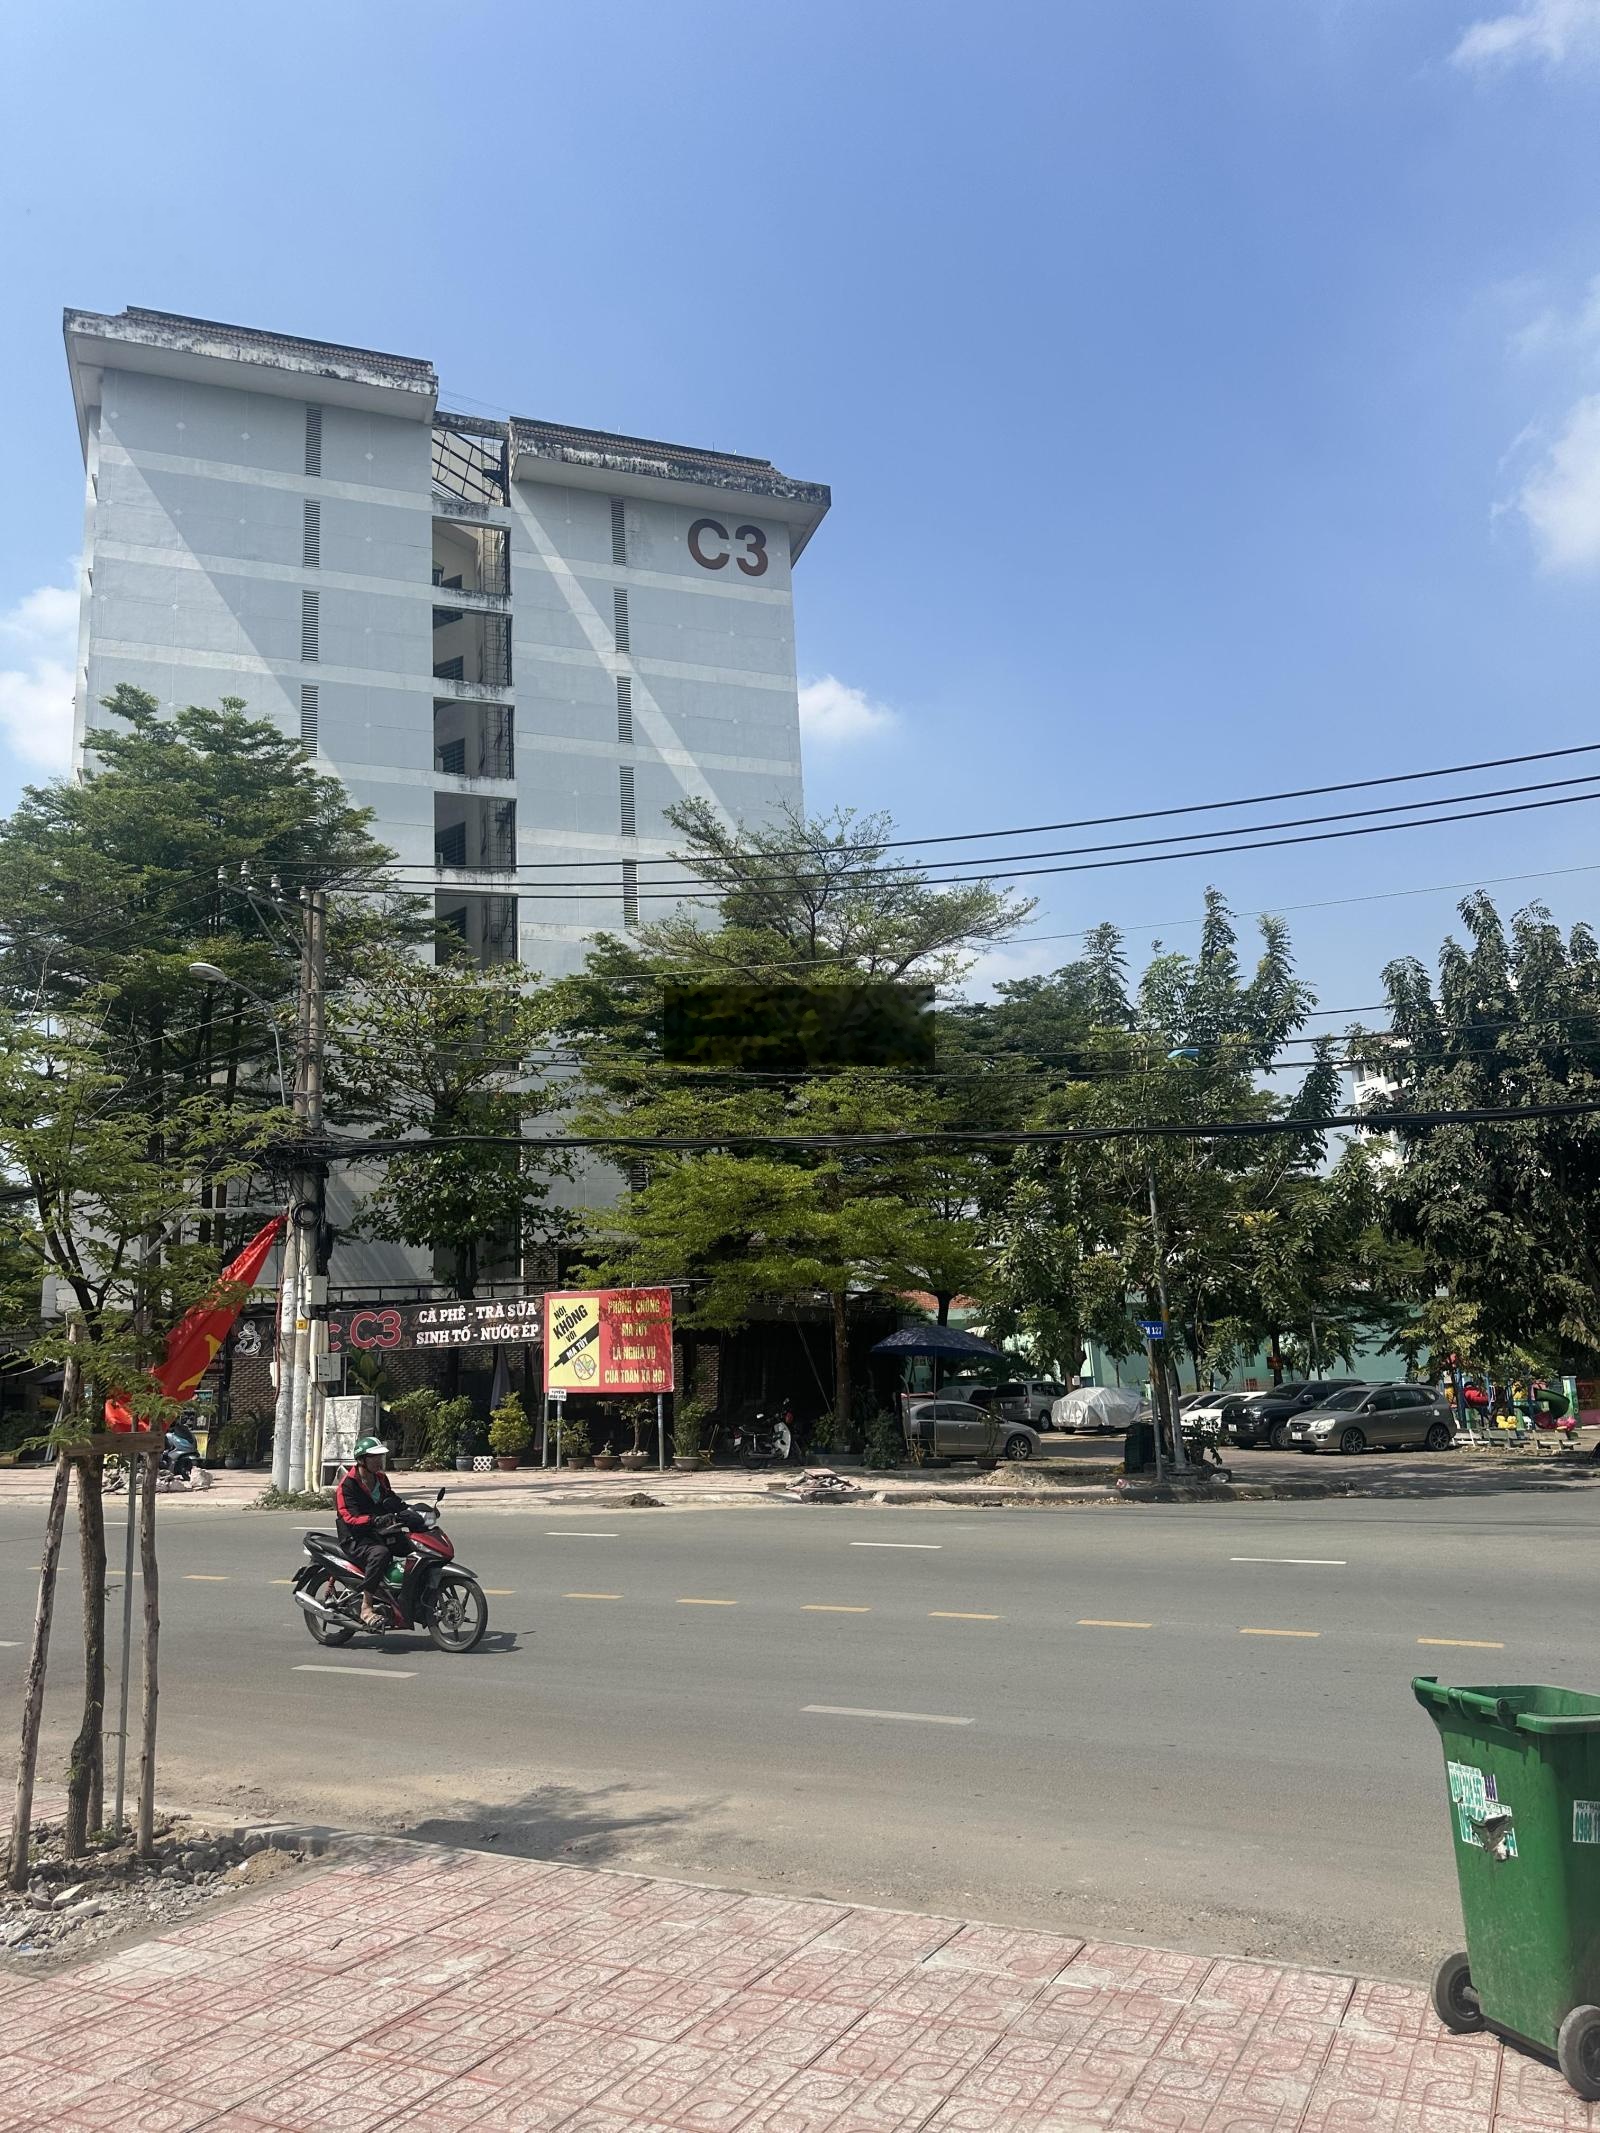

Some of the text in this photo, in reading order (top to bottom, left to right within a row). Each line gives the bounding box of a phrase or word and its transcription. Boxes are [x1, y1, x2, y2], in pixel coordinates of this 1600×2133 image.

[687, 518, 769, 576] C3
[419, 1307, 438, 1323] CÀ
[440, 1305, 466, 1322] PHÊ
[476, 1302, 505, 1319] TRÀ
[507, 1300, 537, 1317] SỮA
[552, 1304, 589, 1340] KHÔNG
[350, 1310, 402, 1349] C3
[416, 1330, 450, 1345] SINH
[452, 1323, 472, 1342] TỐ
[480, 1322, 519, 1340] NƯỚC
[521, 1321, 539, 1338] ÉP
[622, 1323, 633, 1336] MA
[566, 1347, 578, 1360] MA
[604, 1365, 619, 1383] CỦA
[620, 1366, 640, 1383] TOÀN
